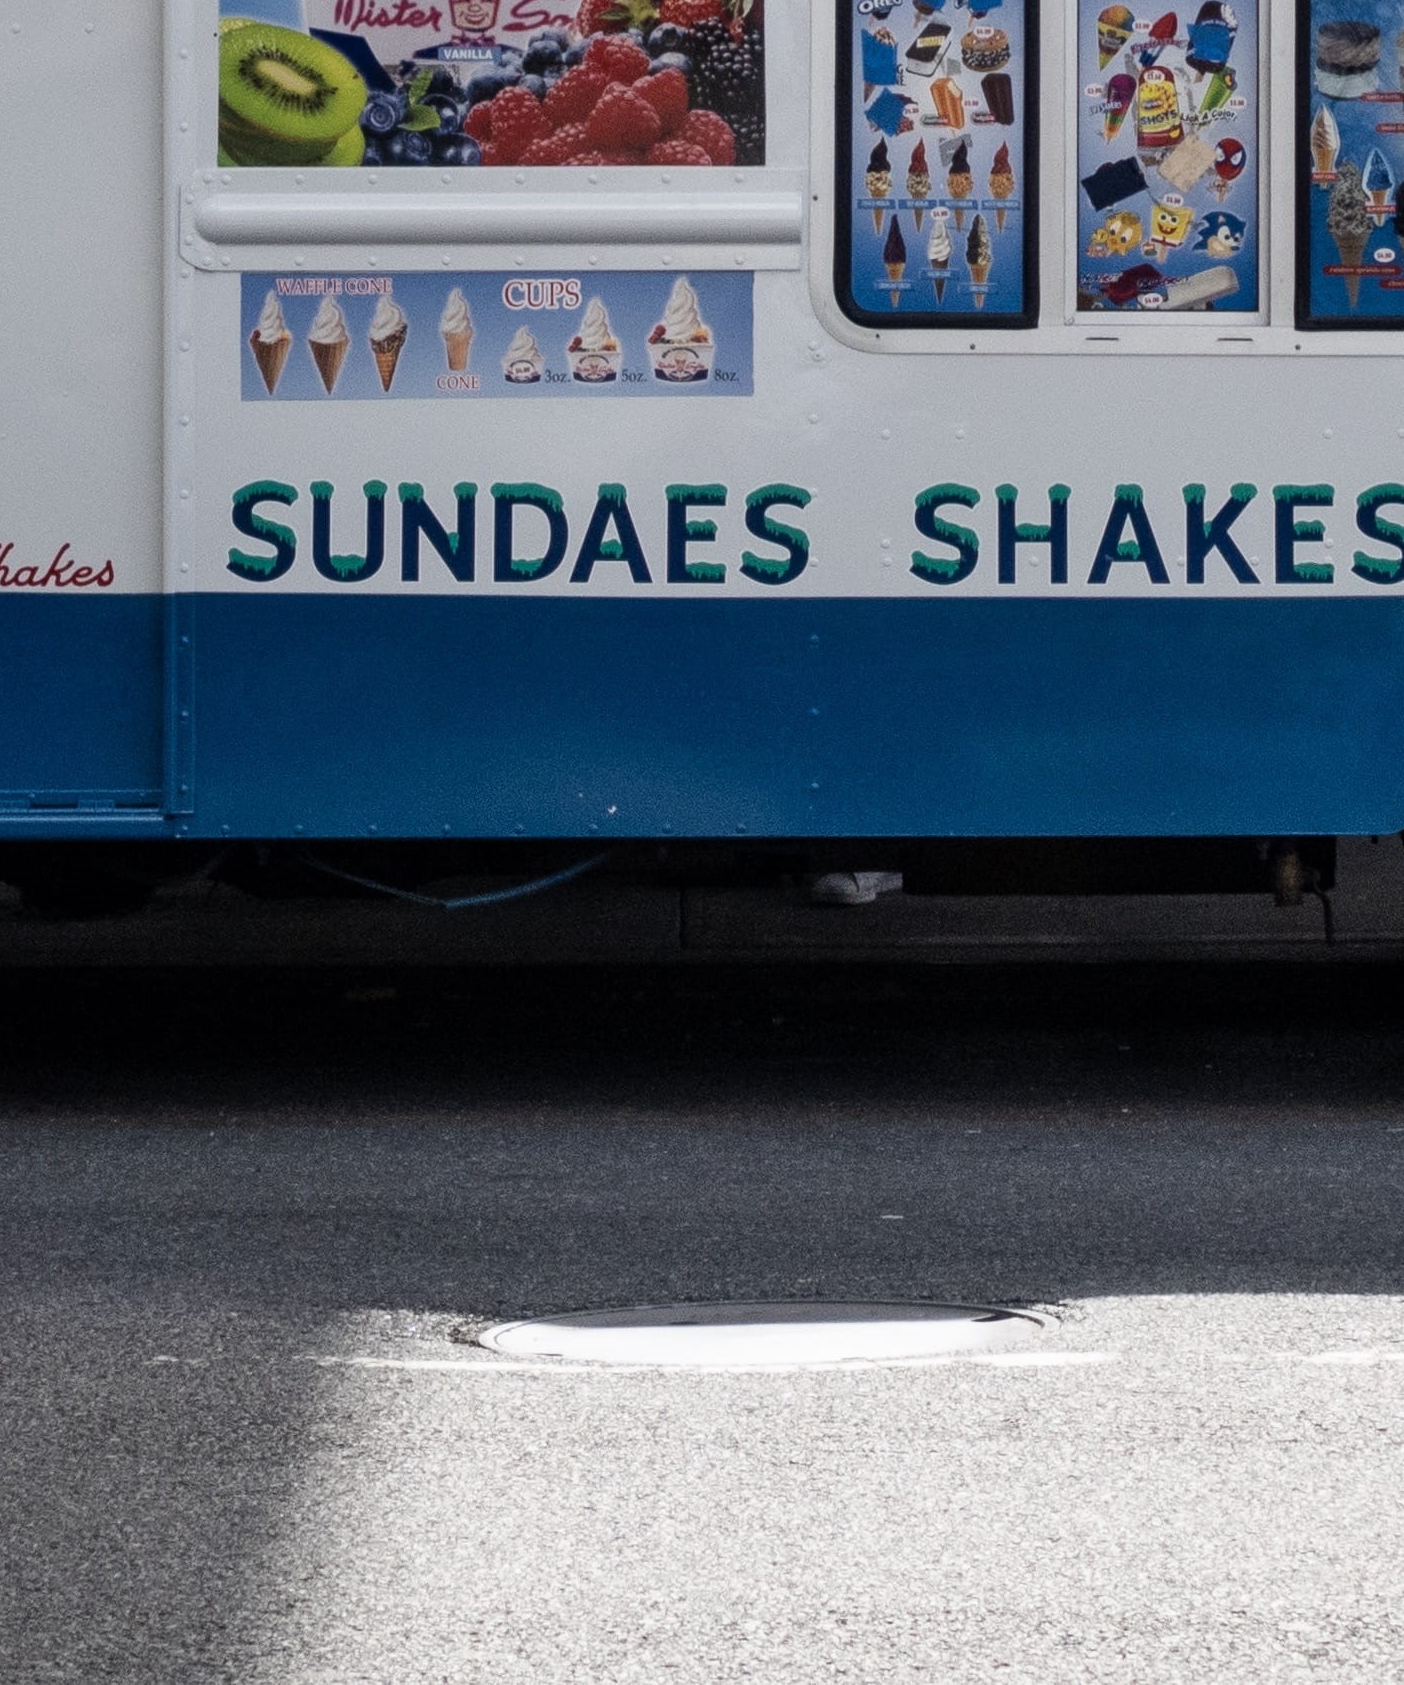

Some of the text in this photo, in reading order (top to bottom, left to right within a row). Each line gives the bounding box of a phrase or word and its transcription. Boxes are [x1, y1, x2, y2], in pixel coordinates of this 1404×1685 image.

[444, 48, 494, 61] VANILLA
[275, 277, 393, 297] WAFFLE CONE
[502, 279, 583, 312] CUPS
[436, 375, 481, 392] CONE
[545, 369, 571, 383] 3oz.
[621, 368, 647, 383] 5oz.
[714, 368, 740, 383] 8oz.
[226, 479, 813, 587] SUNDAES
